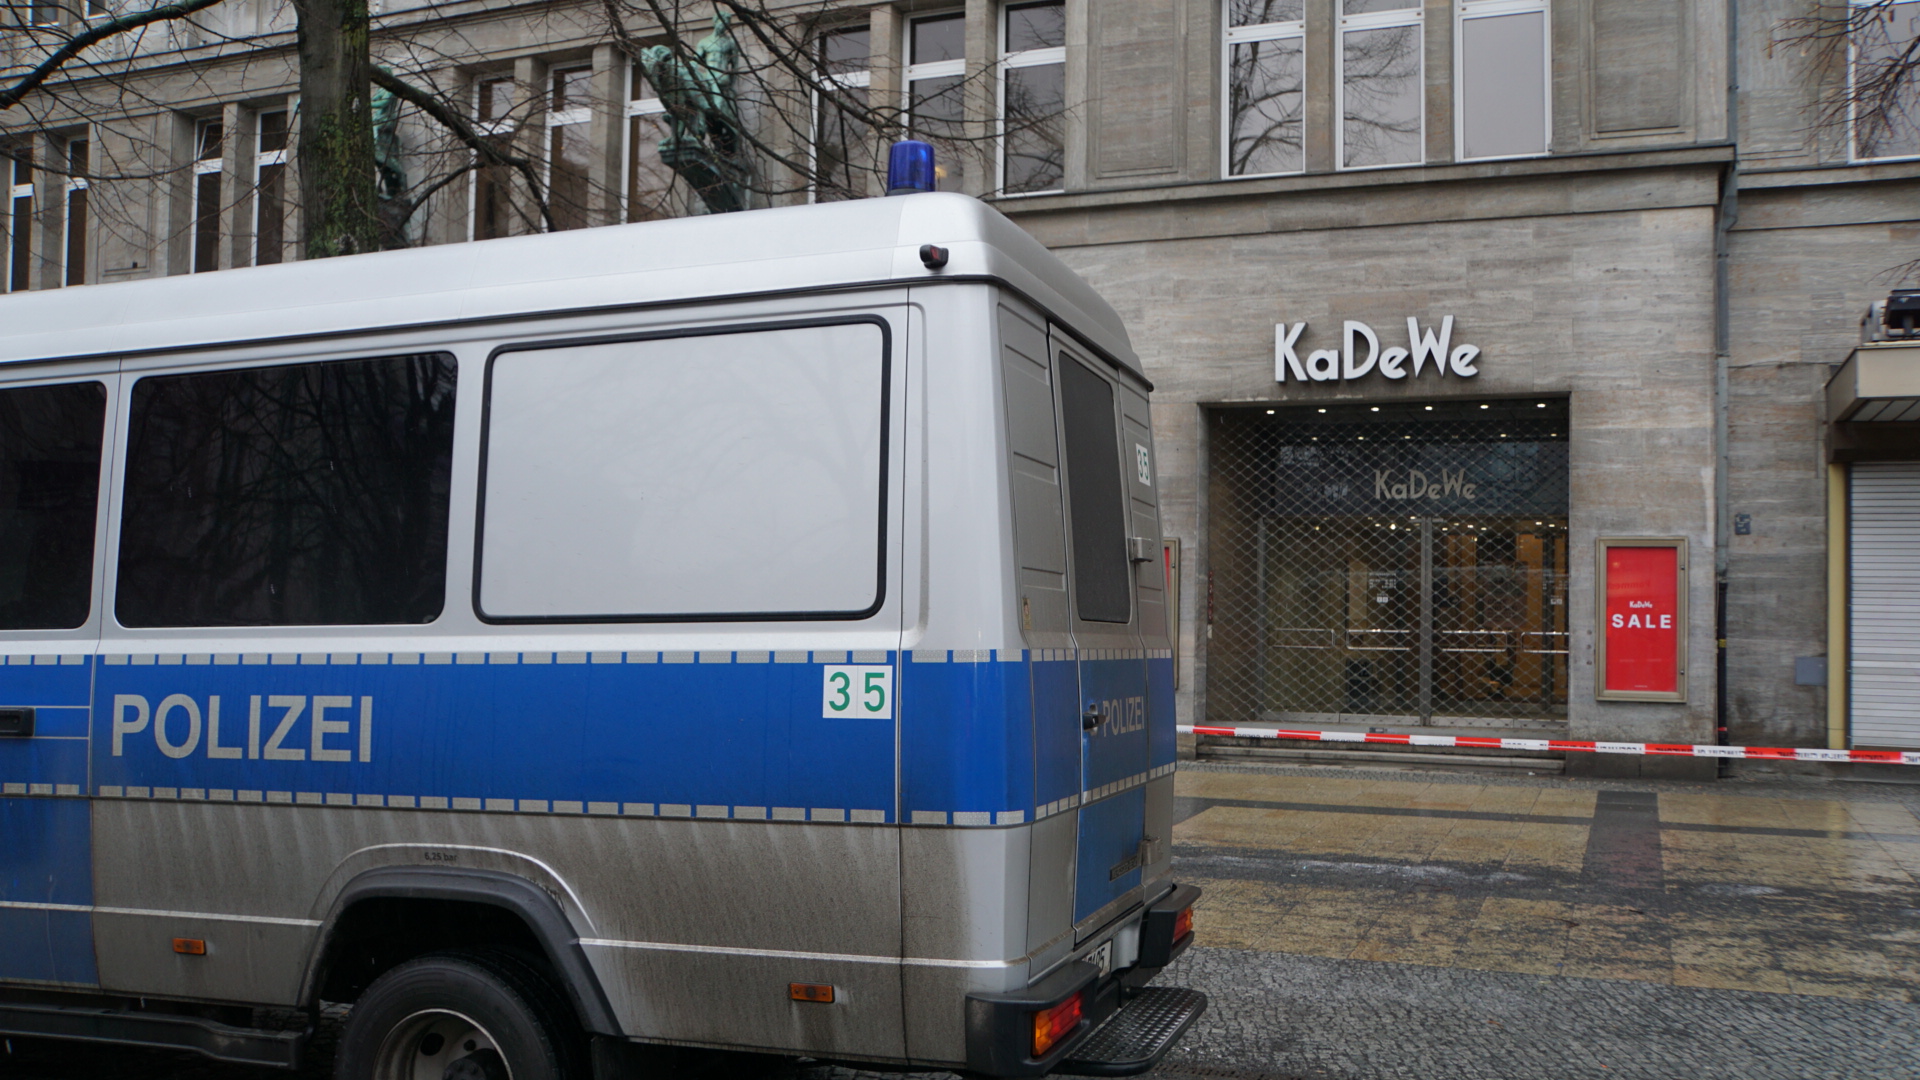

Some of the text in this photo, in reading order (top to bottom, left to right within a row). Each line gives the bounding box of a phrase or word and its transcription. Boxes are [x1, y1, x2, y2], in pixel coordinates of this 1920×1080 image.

[1275, 315, 1480, 382] KaDeWe
[1137, 449, 1149, 481] 35
[1375, 468, 1477, 500] KaDeWe
[1612, 613, 1672, 629] SALE
[828, 671, 885, 712] 35
[112, 693, 373, 763] POLIZEI
[1103, 696, 1144, 737] POLIZEI
[443, 853, 457, 861] bar
